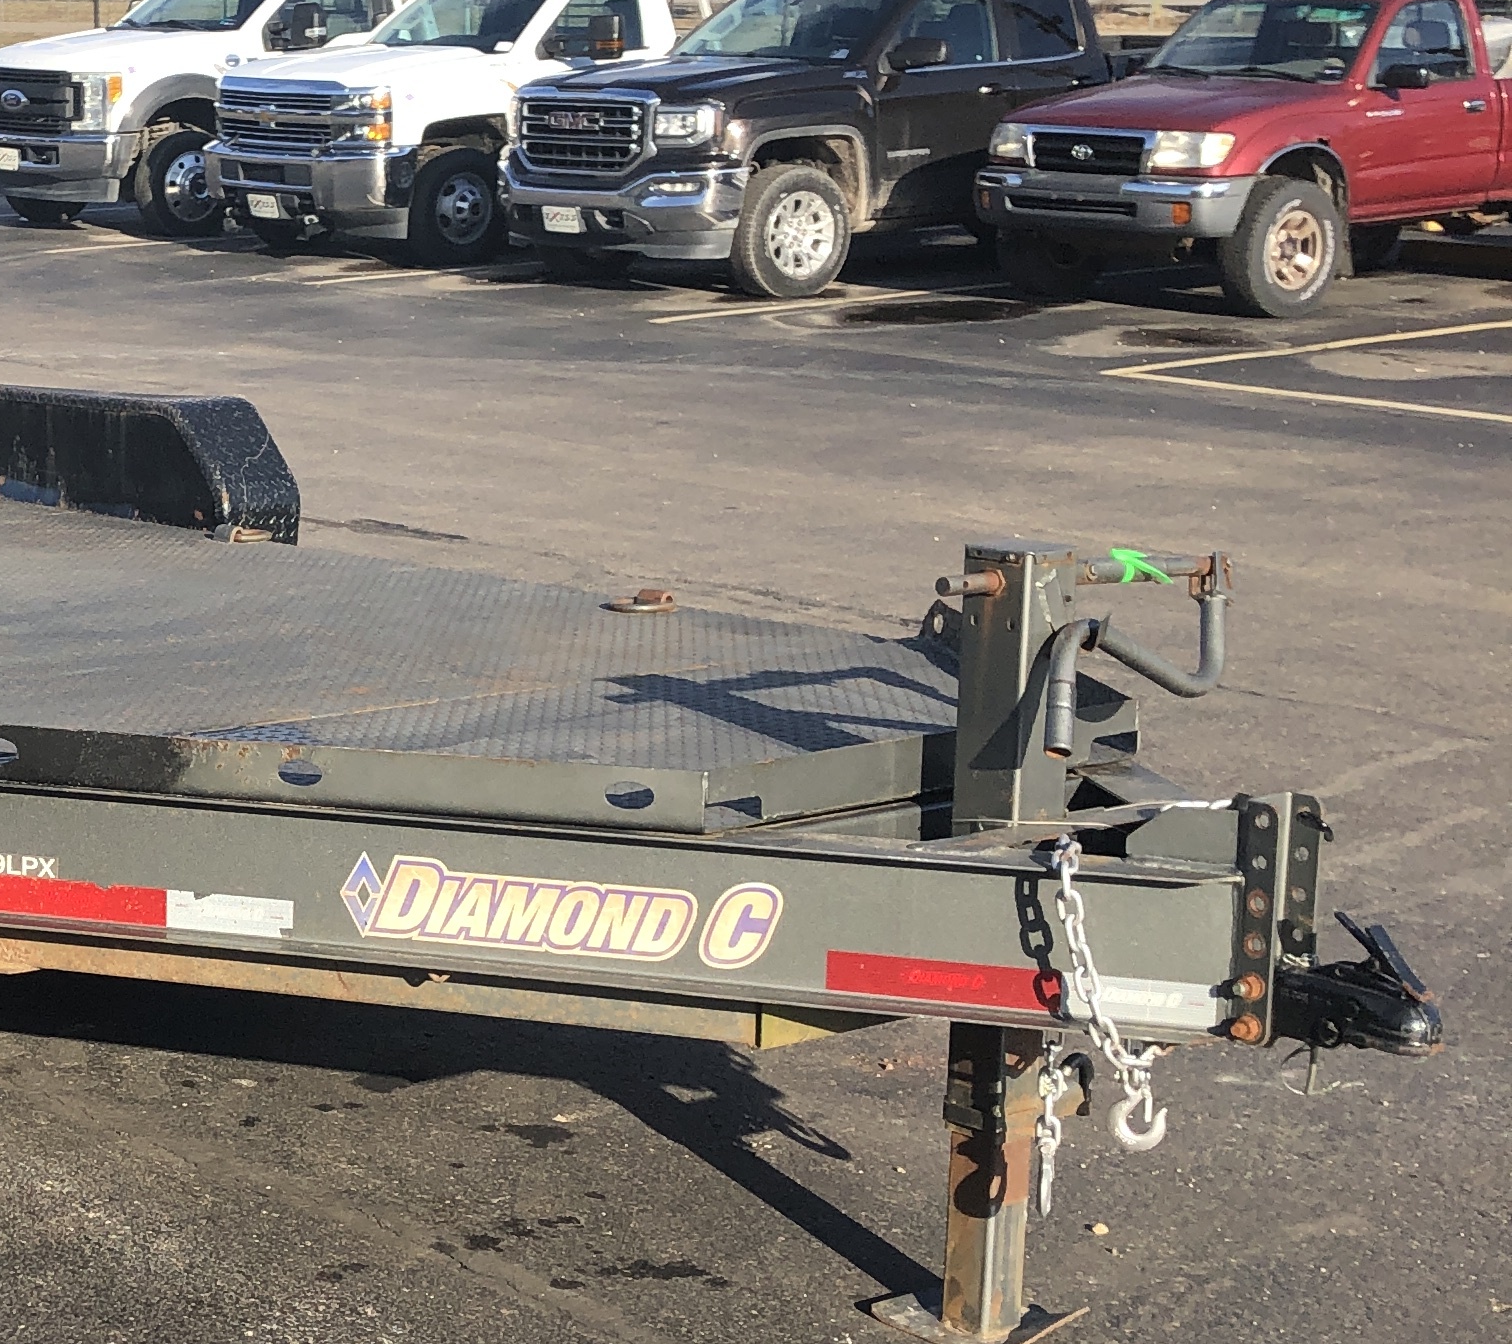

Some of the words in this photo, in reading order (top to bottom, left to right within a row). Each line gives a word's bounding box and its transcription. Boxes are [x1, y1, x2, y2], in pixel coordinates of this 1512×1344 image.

[549, 111, 601, 130] GMC
[369, 856, 699, 960] DIAMOND
[699, 882, 784, 969] C
